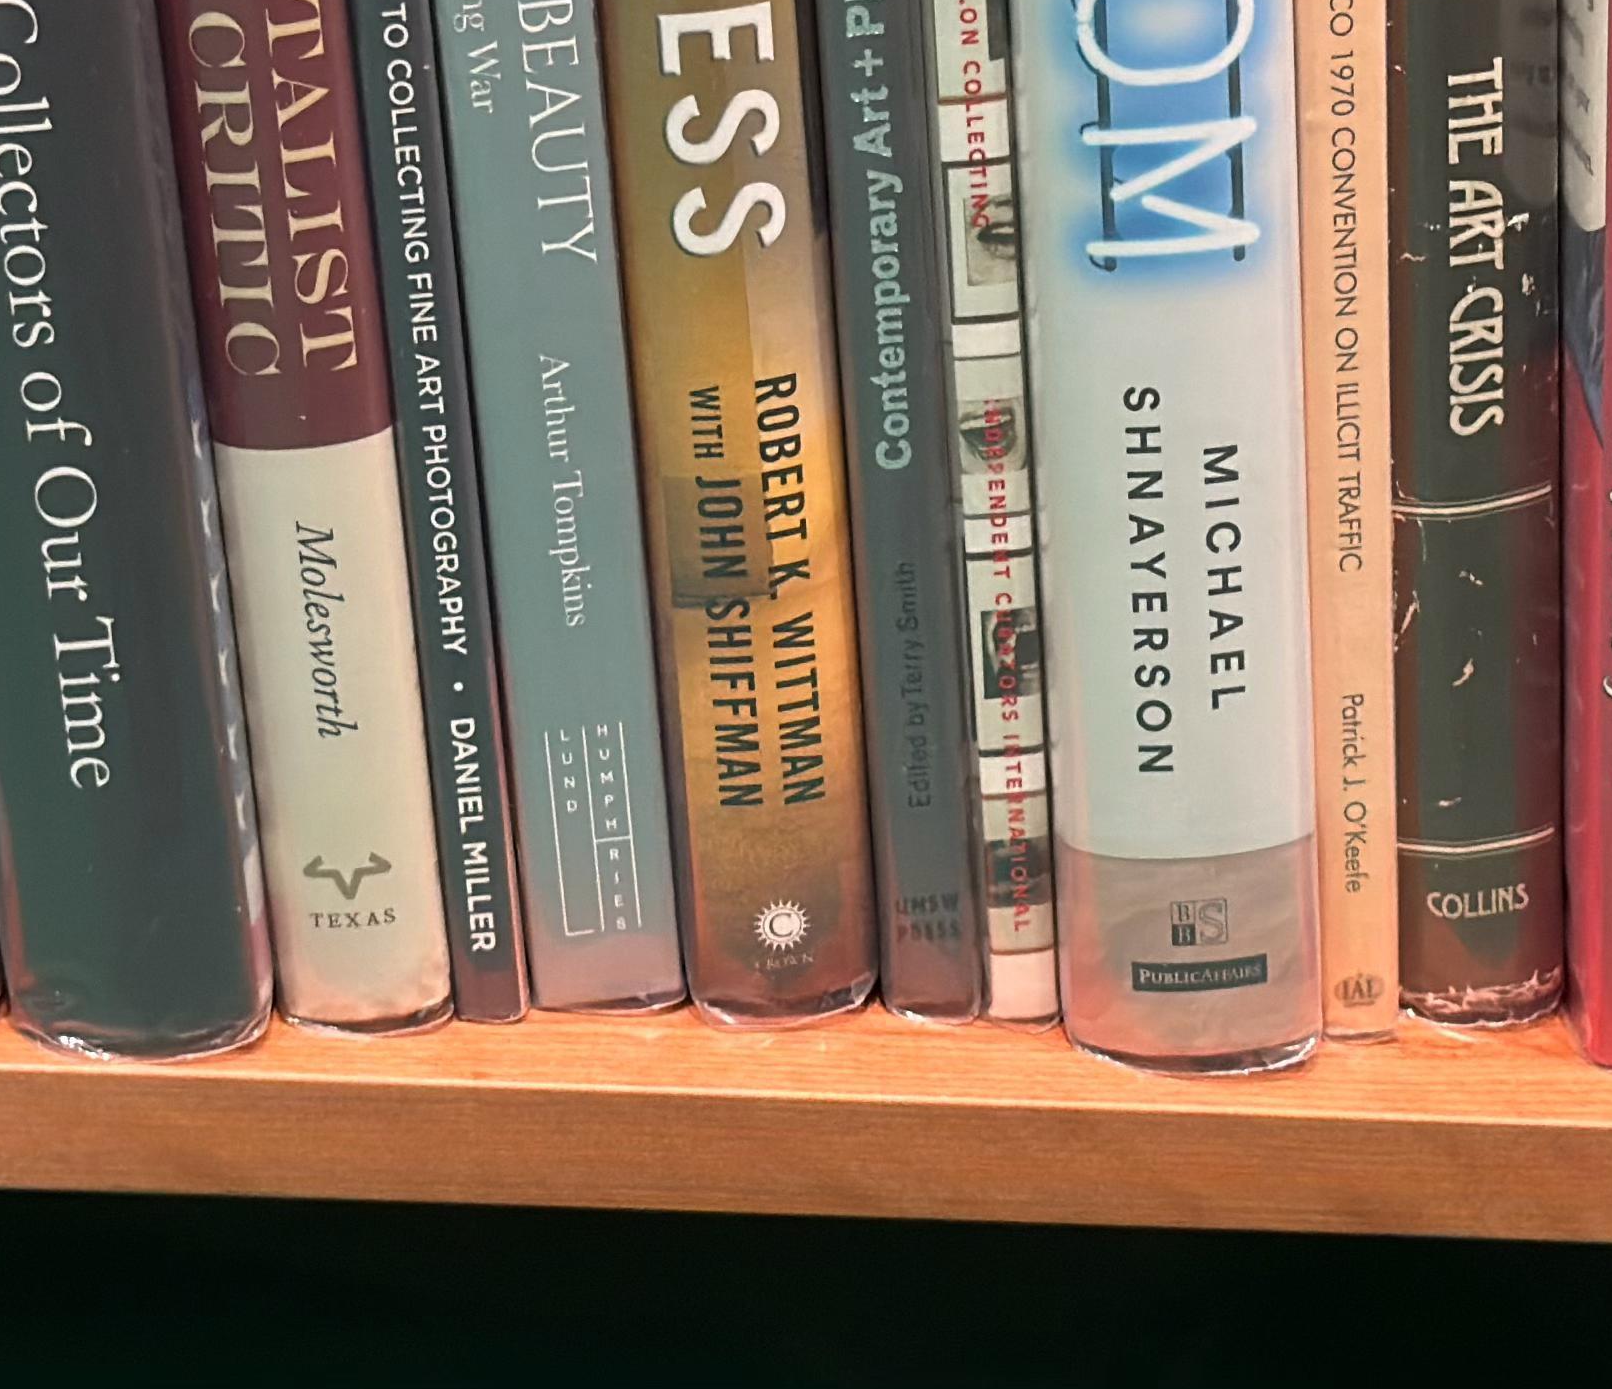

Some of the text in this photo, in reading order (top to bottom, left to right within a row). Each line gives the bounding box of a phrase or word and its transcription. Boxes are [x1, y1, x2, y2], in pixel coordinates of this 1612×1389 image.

[376, 1, 408, 48] TO
[467, 40, 502, 115] War
[1329, 51, 1355, 116] 1970
[188, 12, 283, 376] CRITIC
[384, 60, 428, 262] COLLECTING
[1330, 127, 1358, 317] CONVENTION
[1447, 56, 1504, 437] THE ART CRISIS
[407, 272, 438, 343] FINE
[1335, 328, 1358, 372] ON
[20, 371, 93, 443] of
[414, 353, 442, 415] ART
[1336, 382, 1359, 461] ILLICIT
[33, 466, 97, 601] Our
[422, 424, 468, 655] PHOTOGRAPHY
[1203, 444, 1247, 710] MICHAEL
[1337, 470, 1363, 573] TRAFFIC
[296, 520, 358, 737] Molesworth
[1122, 386, 1175, 774] SHNAYERSON
[53, 616, 120, 788] Time
[450, 716, 484, 832] DANIEL
[309, 908, 397, 928] TEXAS
[462, 841, 497, 952] MILLER
[1427, 883, 1529, 919] COLLINS
